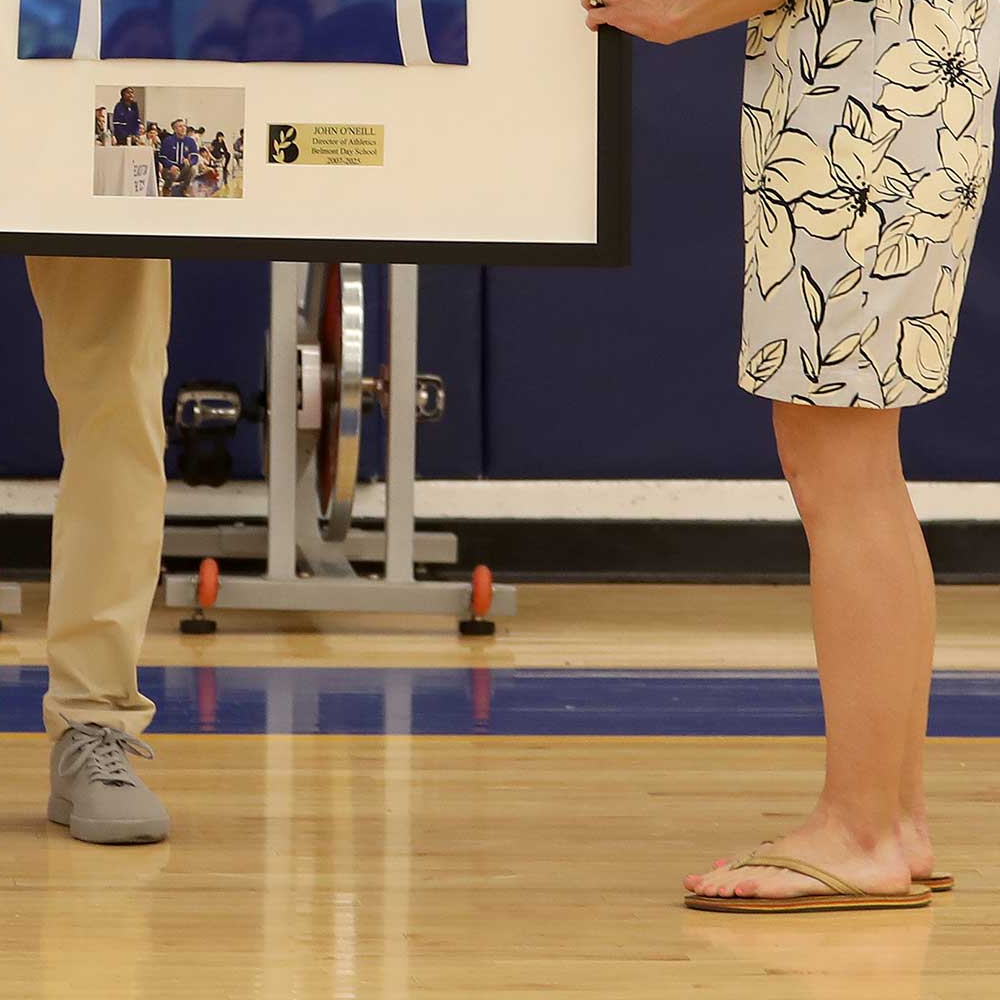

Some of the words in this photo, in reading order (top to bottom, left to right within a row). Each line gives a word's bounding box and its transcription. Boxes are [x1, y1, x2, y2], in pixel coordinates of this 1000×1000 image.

[313, 126, 338, 135] JOHN
[340, 127, 376, 136] O'NEILL
[311, 147, 338, 155] Belmont
[340, 147, 354, 156] Day
[354, 148, 377, 156] School
